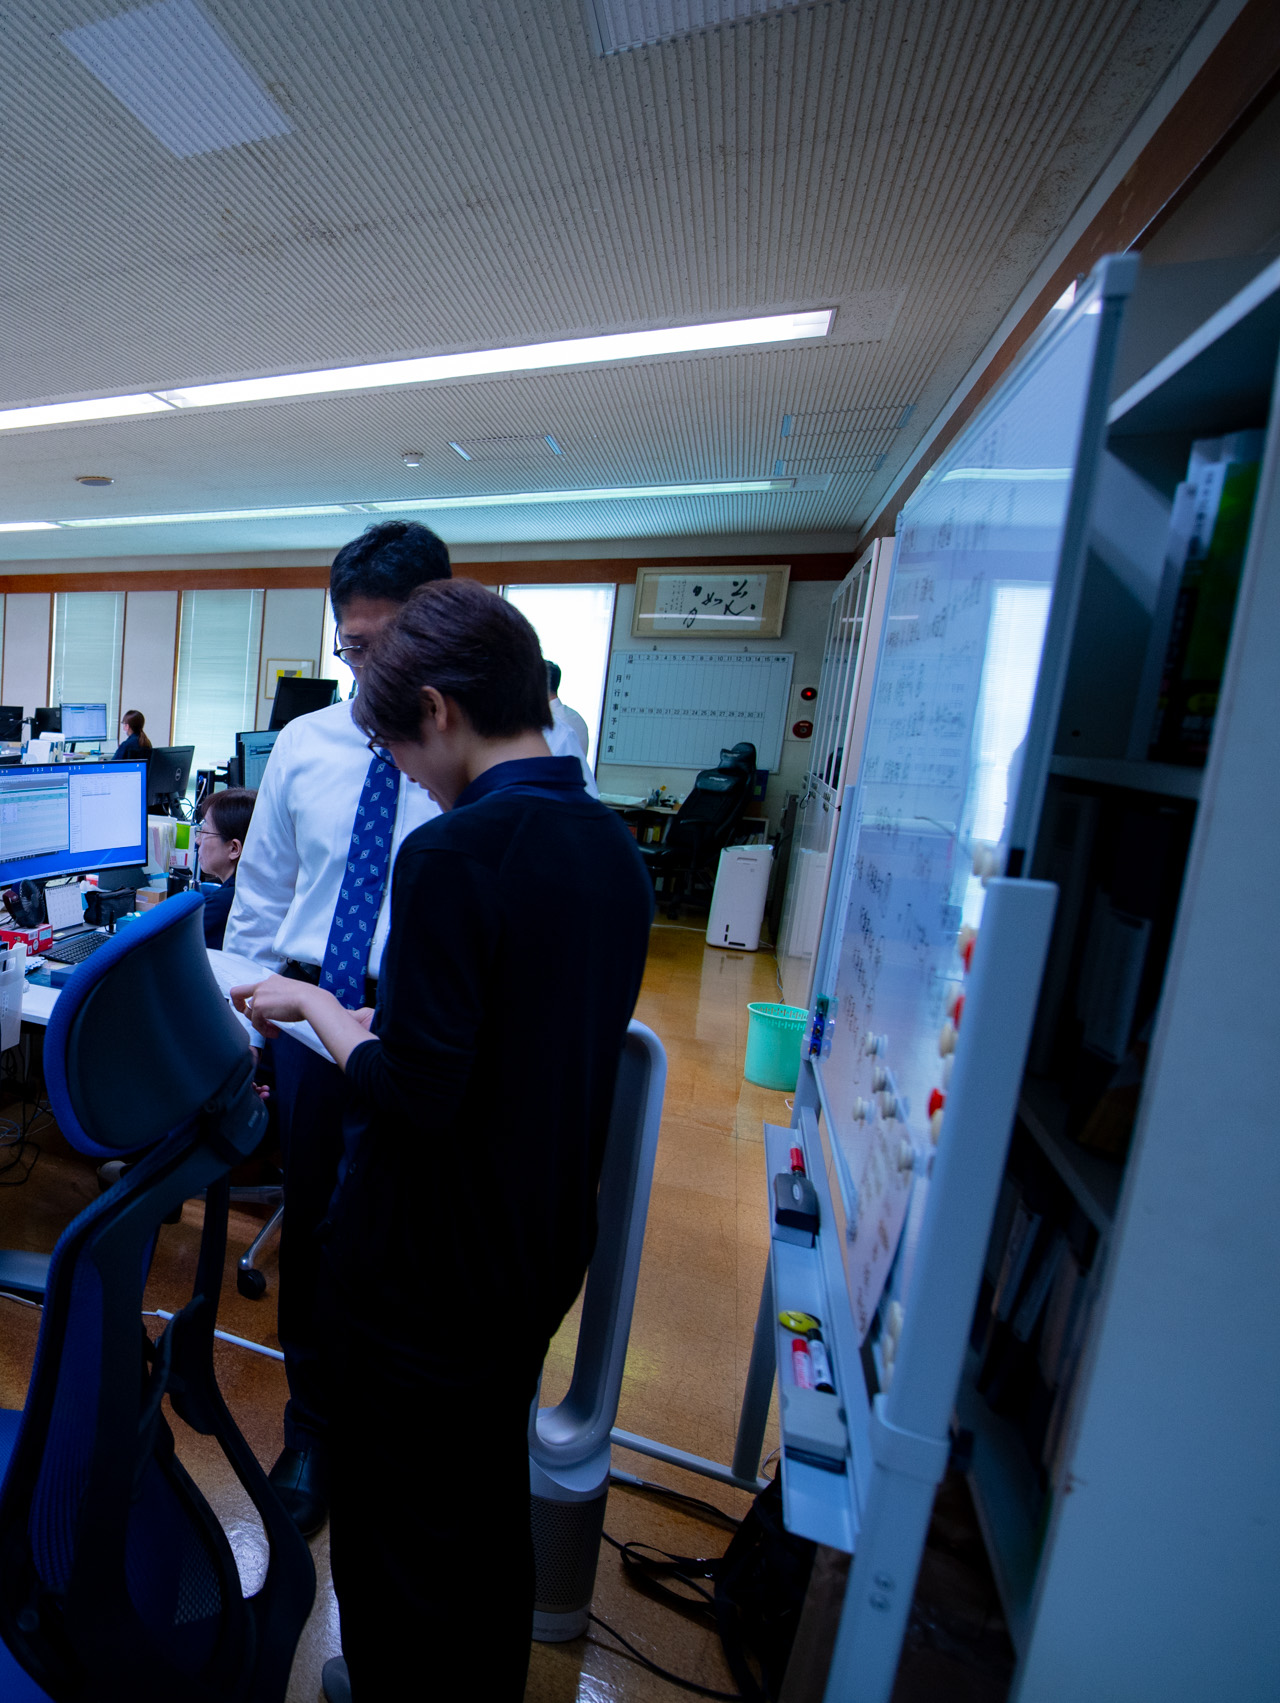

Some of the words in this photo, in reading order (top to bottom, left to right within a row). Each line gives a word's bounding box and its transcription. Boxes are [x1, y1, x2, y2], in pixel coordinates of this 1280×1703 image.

[607, 674, 622, 753] 月行事予定表
